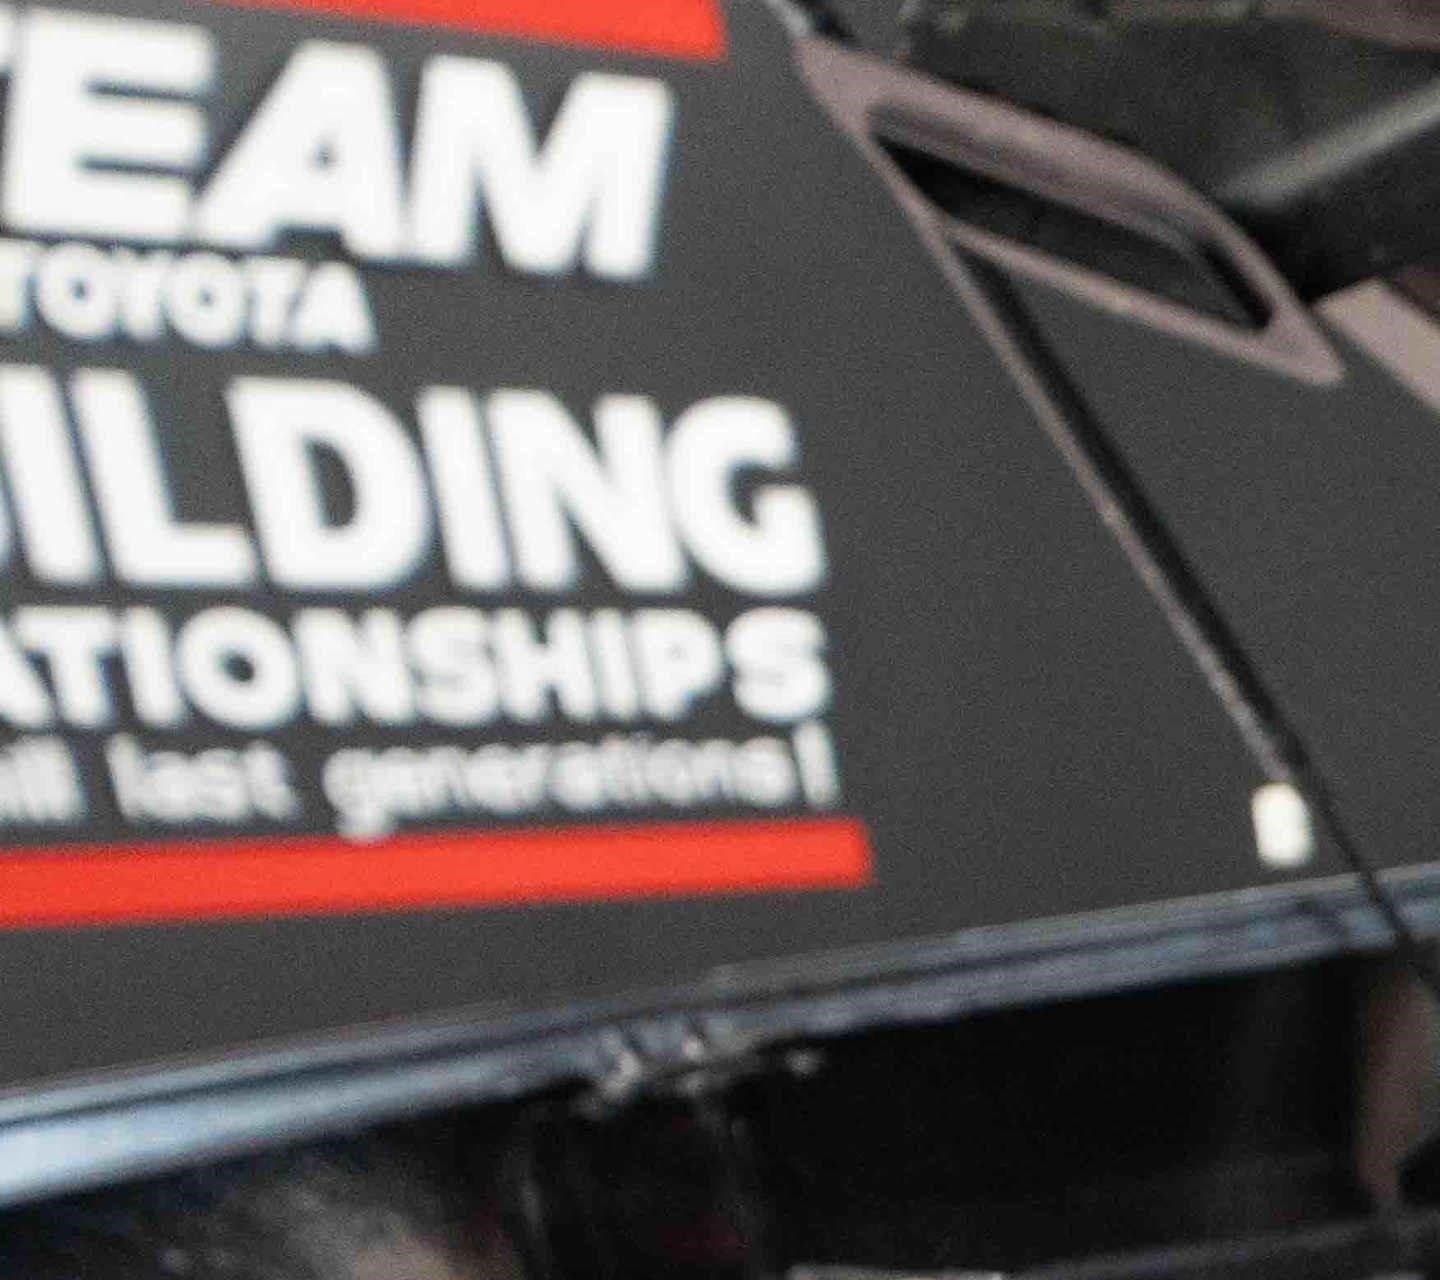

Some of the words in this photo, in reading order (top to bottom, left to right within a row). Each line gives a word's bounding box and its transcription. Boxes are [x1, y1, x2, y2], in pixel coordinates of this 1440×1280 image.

[0, 5, 674, 280] EAM
[0, 362, 826, 596] ILDING
[106, 734, 296, 822] last
